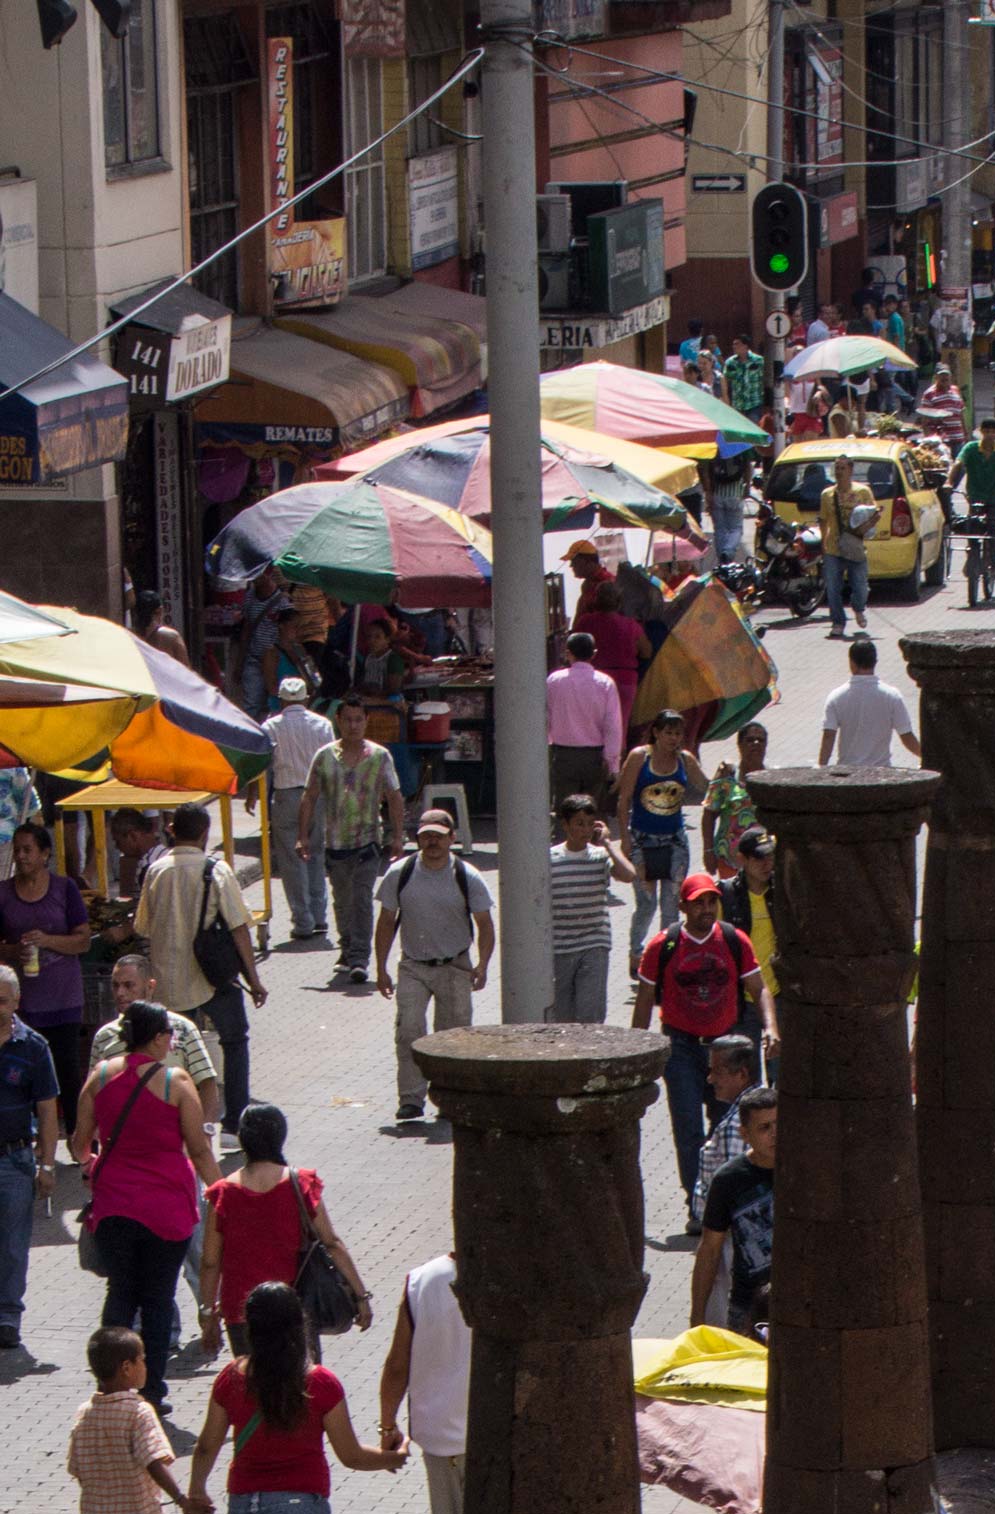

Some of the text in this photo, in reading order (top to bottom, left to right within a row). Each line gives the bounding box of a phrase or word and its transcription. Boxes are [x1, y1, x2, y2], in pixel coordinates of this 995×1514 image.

[274, 47, 289, 230] RESTAURANTE
[540, 325, 594, 346] ERIA
[131, 341, 161, 368] 141
[175, 349, 223, 393] DORADO
[130, 374, 158, 394] 141
[265, 425, 333, 443] REMATES
